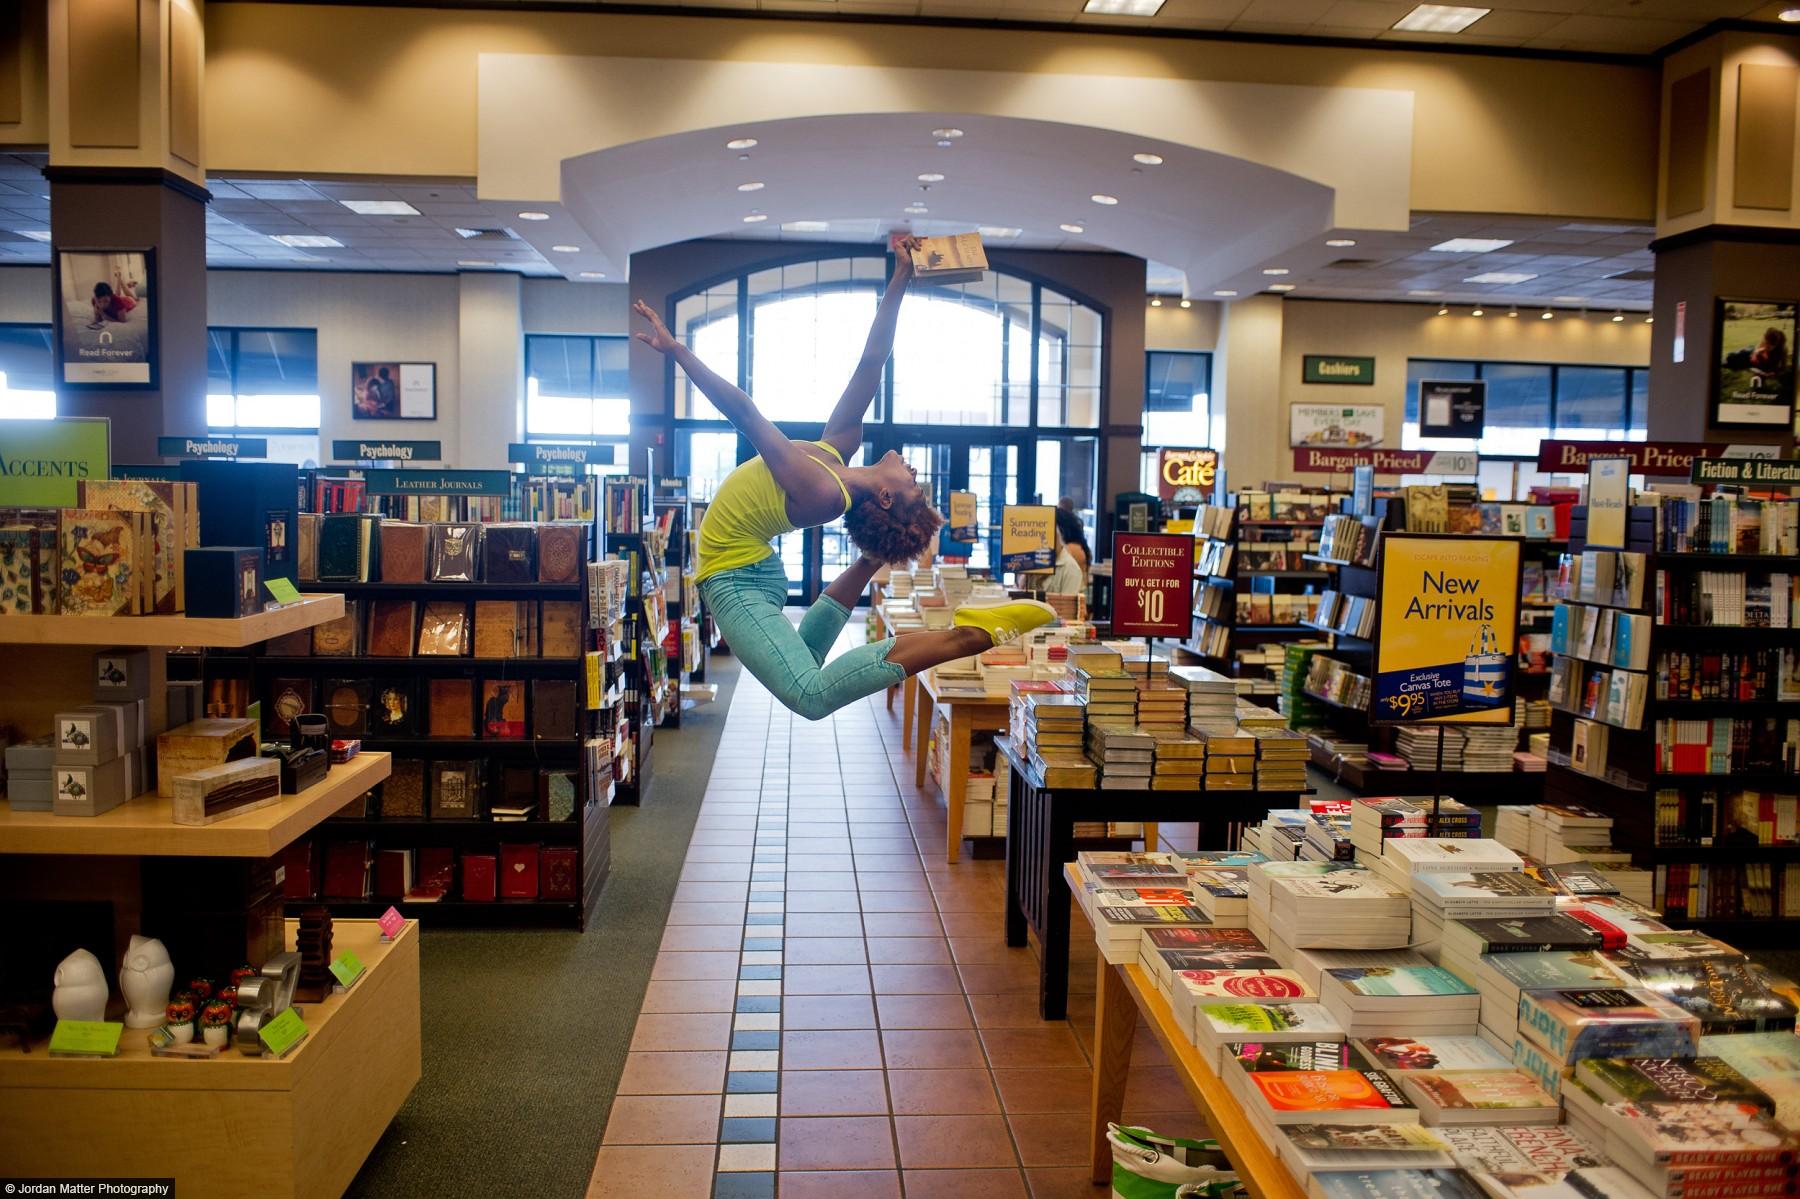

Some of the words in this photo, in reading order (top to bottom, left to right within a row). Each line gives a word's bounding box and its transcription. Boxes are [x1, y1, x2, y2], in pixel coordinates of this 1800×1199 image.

[79, 348, 100, 357] Read
[102, 348, 134, 357] Forever
[1318, 361, 1361, 376] Cashiers
[186, 440, 239, 456] Psychology
[360, 443, 413, 460] Psychology
[536, 446, 587, 463] Psychology
[1309, 451, 1369, 470] Bargain
[1373, 452, 1421, 469] Priced
[1163, 458, 1215, 485] Café
[1700, 461, 1738, 479] Fiction
[1742, 463, 1752, 479] &
[395, 477, 437, 489] LEATHER
[439, 477, 483, 490] JOURNALS
[1009, 518, 1048, 528] Summer
[1011, 527, 1047, 540] Reading
[1121, 543, 1185, 557] COLLECTIBLE
[1132, 555, 1175, 568] EDITIONS
[1125, 578, 1139, 587] BUY
[1146, 578, 1160, 587] GET
[1166, 579, 1180, 588] FOR
[1422, 570, 1480, 594] New
[1138, 588, 1164, 622] $10
[1404, 596, 1494, 622] Arrivals
[1400, 682, 1431, 692] Canvas
[1432, 679, 1452, 688] Tote
[1410, 672, 1440, 682] Exclusive
[1300, 1046, 1313, 1070] GODDESS
[1635, 1059, 1696, 1098] HARLAN
[1653, 1058, 1718, 1100] COBEN
[1374, 1080, 1404, 1105] GRAFTON
[1440, 1127, 1480, 1153] PLACE
[1464, 1126, 1520, 1168] FAITHFUL
[1535, 1126, 1585, 1155] TANA
[1502, 1126, 1569, 1173] FRENCH
[1676, 1153, 1711, 1163] READY
[1713, 1153, 1753, 1162] PLAYER
[1756, 1153, 1777, 1161] ONE
[1688, 1171, 1721, 1181] READY
[1724, 1169, 1761, 1178] PLAYER
